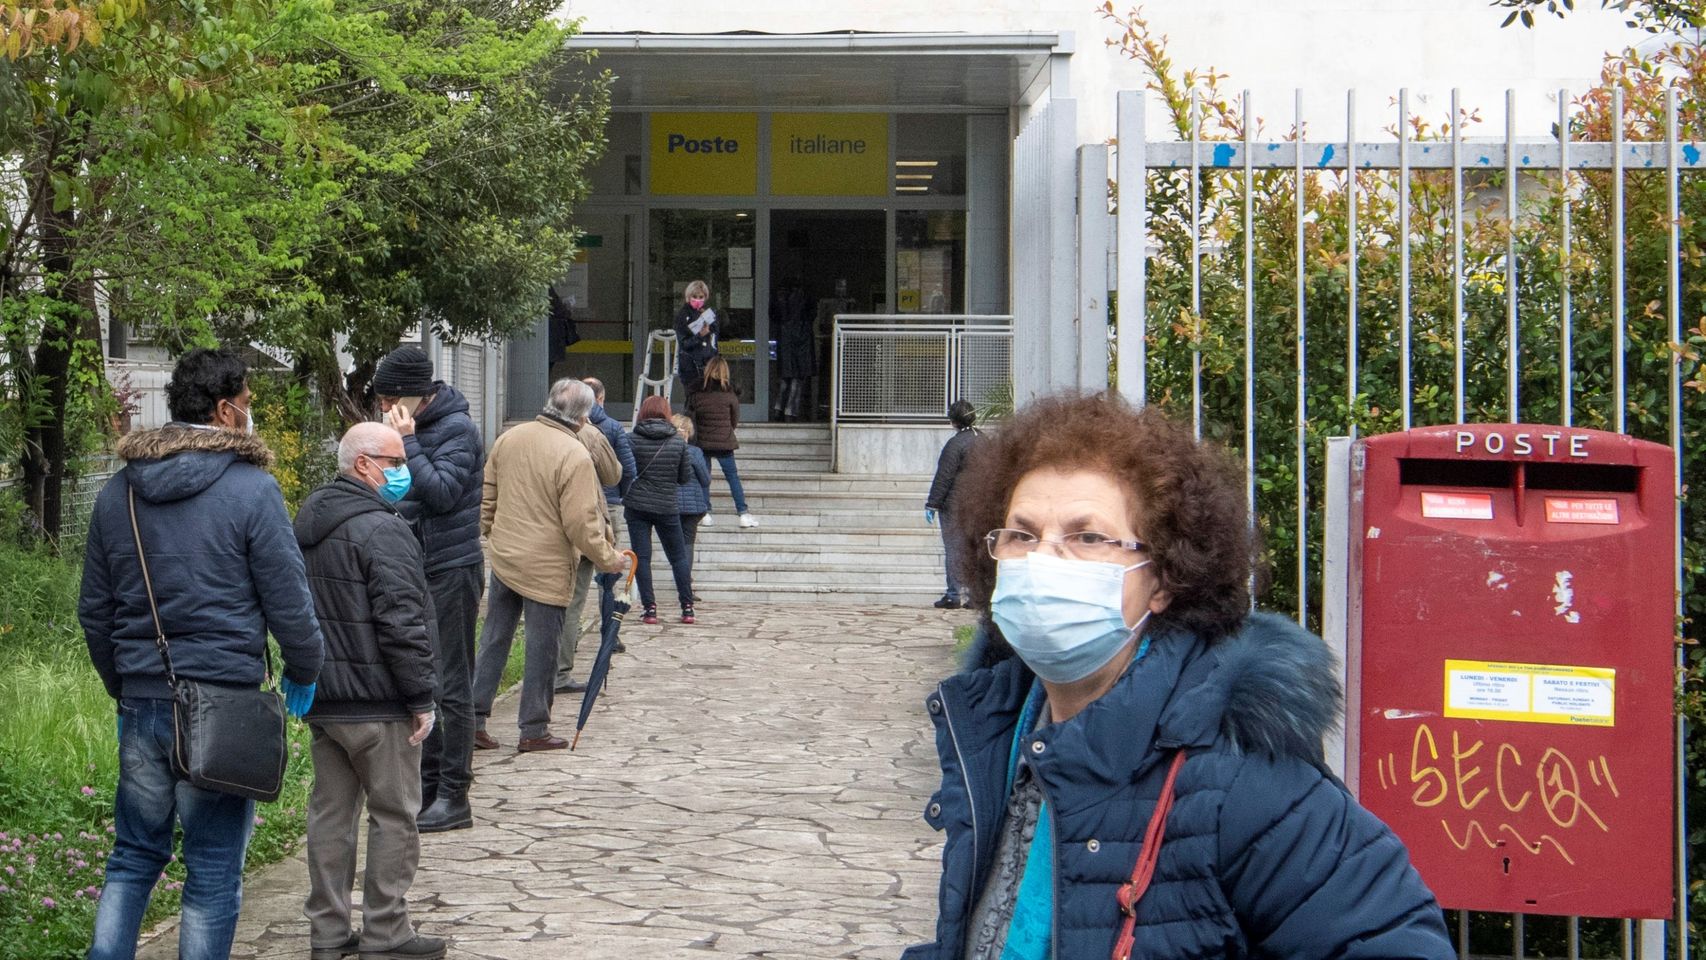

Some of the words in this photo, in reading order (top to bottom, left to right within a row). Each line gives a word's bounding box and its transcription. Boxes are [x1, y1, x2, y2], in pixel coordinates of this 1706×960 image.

[668, 134, 739, 154] Poste
[790, 134, 866, 154] italiane
[1456, 431, 1589, 457] POSTE
